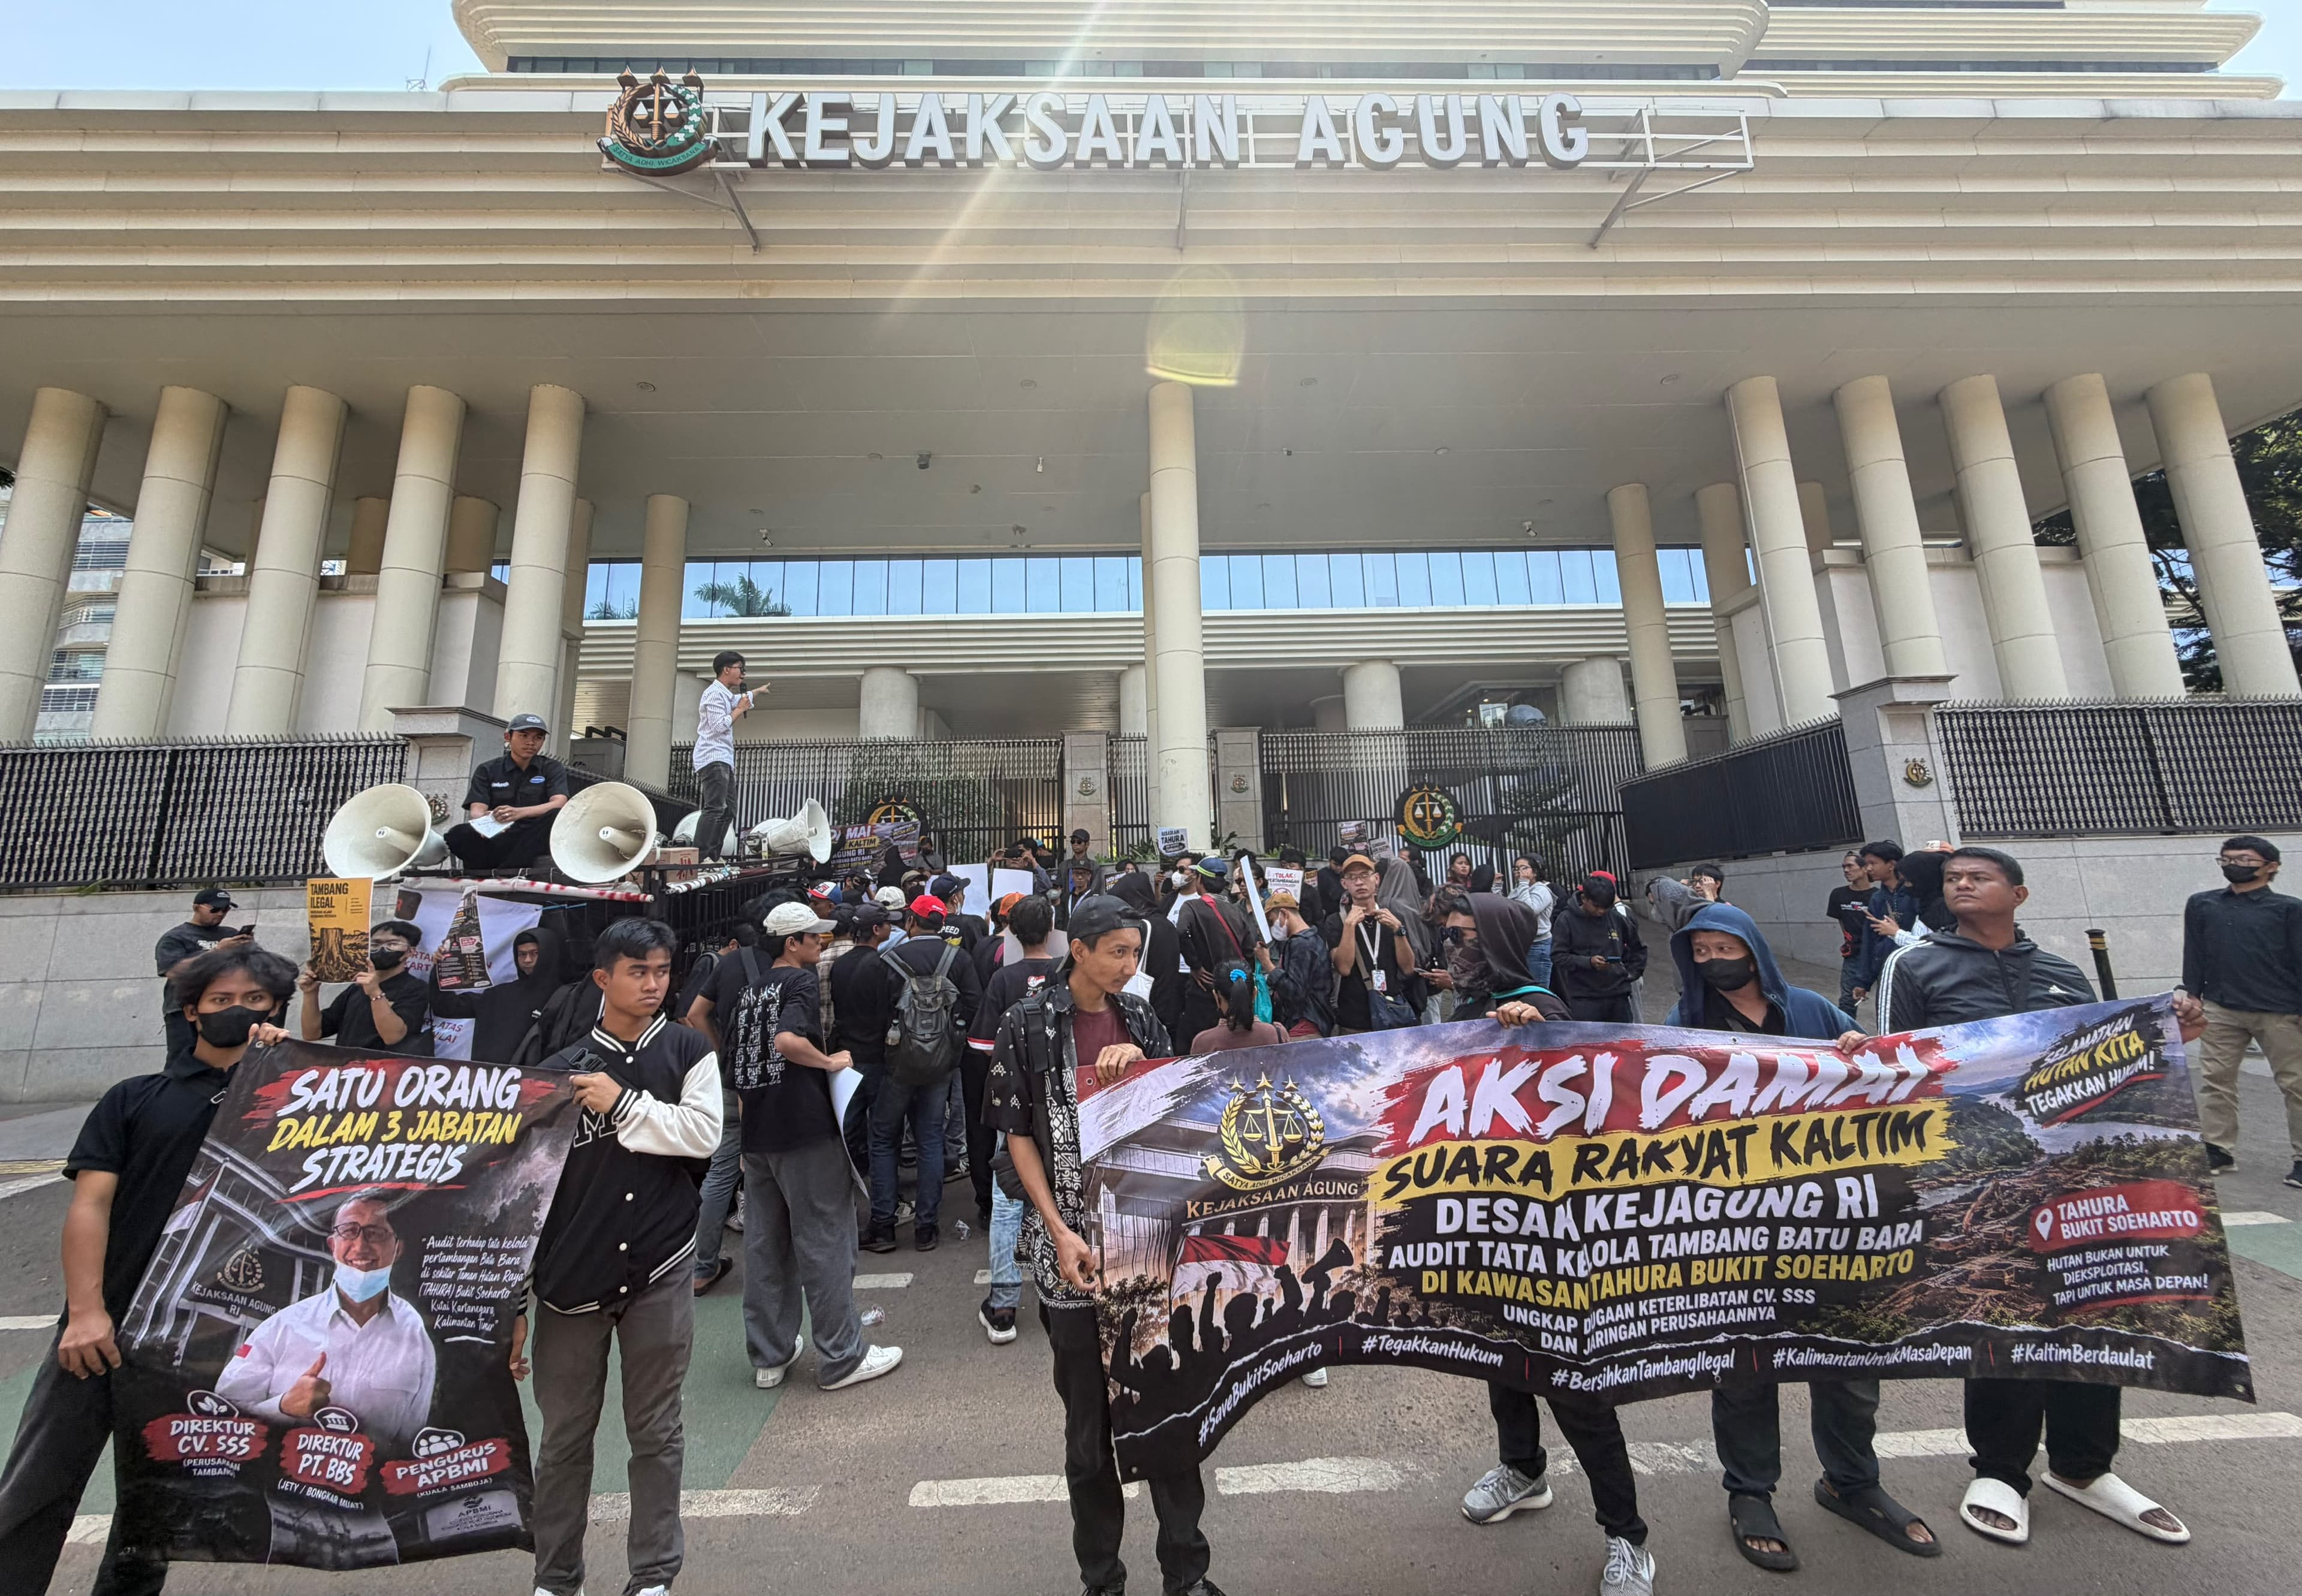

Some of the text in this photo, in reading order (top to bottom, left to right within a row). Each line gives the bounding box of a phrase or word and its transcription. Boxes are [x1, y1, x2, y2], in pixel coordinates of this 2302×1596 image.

[748, 92, 1589, 169] KEJAKSAAN AGUNG
[613, 146, 700, 166] SATYA ADHI WICAKSANA
[849, 838, 876, 847] KALTIM
[1161, 834, 1185, 844] TAHURA
[311, 883, 348, 895] TAMBANG
[311, 897, 335, 909] ILEGAL
[437, 1021, 463, 1031] ATAS
[2024, 1030, 2145, 1093] HUTAN KITA
[276, 1066, 522, 1117] SATU ORANG
[1408, 1042, 1928, 1147] AKSI DAMAI
[2025, 1073, 2107, 1116] TEGAKKAN
[267, 1111, 523, 1153] DALAM 3 JABATAN
[288, 1143, 468, 1194] STRATEGIS
[1383, 1109, 1935, 1198] SUARA RAKYAT KALTIM
[1223, 1158, 1316, 1189] SATYA ADHI WICAKSANA
[1186, 1181, 1358, 1219] KEJAKSAAN AGUNG
[1436, 1173, 1879, 1241] DESAK KEJAGUNG RI
[2057, 1194, 2129, 1221] TAHURA
[2060, 1210, 2198, 1239] BUKIT SOEHARTO
[456, 1236, 486, 1251] terhadap
[502, 1235, 528, 1248] kelola
[1388, 1219, 1923, 1278] AUDIT TATA KELOLA TAMBANG BATU BARA
[2047, 1245, 2169, 1272] HUTAN BUKAN UNTUK
[422, 1251, 521, 1269] pertambangan Batu Bara
[418, 1282, 511, 1299] (TAHURA) Bukit Soeharto
[420, 1266, 525, 1287] di sekitar Taman Hutan Raya
[1422, 1249, 1915, 1311] DI KAWASAN TAHURA BUKIT SOEHARTO
[2053, 1274, 2208, 1305] TAPI UNTUK MASA DEPAN!
[191, 1281, 276, 1314] KEJAKSAAN AGUNG
[230, 1305, 240, 1316] RI
[431, 1299, 450, 1312] Kutai
[1503, 1289, 1816, 1335] UNGKAP DUGAAN KETERLIBATAN CV. SSS
[434, 1314, 475, 1329] Kalimantan
[1541, 1307, 1776, 1355] DAN JARINGAN PERUSAHAANNYA
[1362, 1335, 1503, 1368] #TegakkanHukum
[1773, 1344, 1972, 1369] #KalimantanUntukMasaDepan
[2011, 1342, 2157, 1370] #KaltimBerdaulat
[1551, 1348, 1735, 1392] #BersihkanTambangIlegal
[1198, 1344, 1322, 1447] #SaveBukitSoeharto
[170, 1419, 255, 1436] DIREKTUR
[178, 1435, 250, 1456] CV. SSS
[297, 1434, 363, 1461] DIREKTUR
[396, 1443, 496, 1479] PENGURUS
[298, 1453, 356, 1485] PT. BBS
[417, 1457, 488, 1488] APBMI
[278, 1478, 300, 1492] (JETY
[306, 1487, 338, 1504] BONGKAR
[339, 1498, 364, 1510] MUAT)
[417, 1477, 493, 1498] (KUALA SAMBOJA)
[458, 1505, 492, 1517] APBMI
